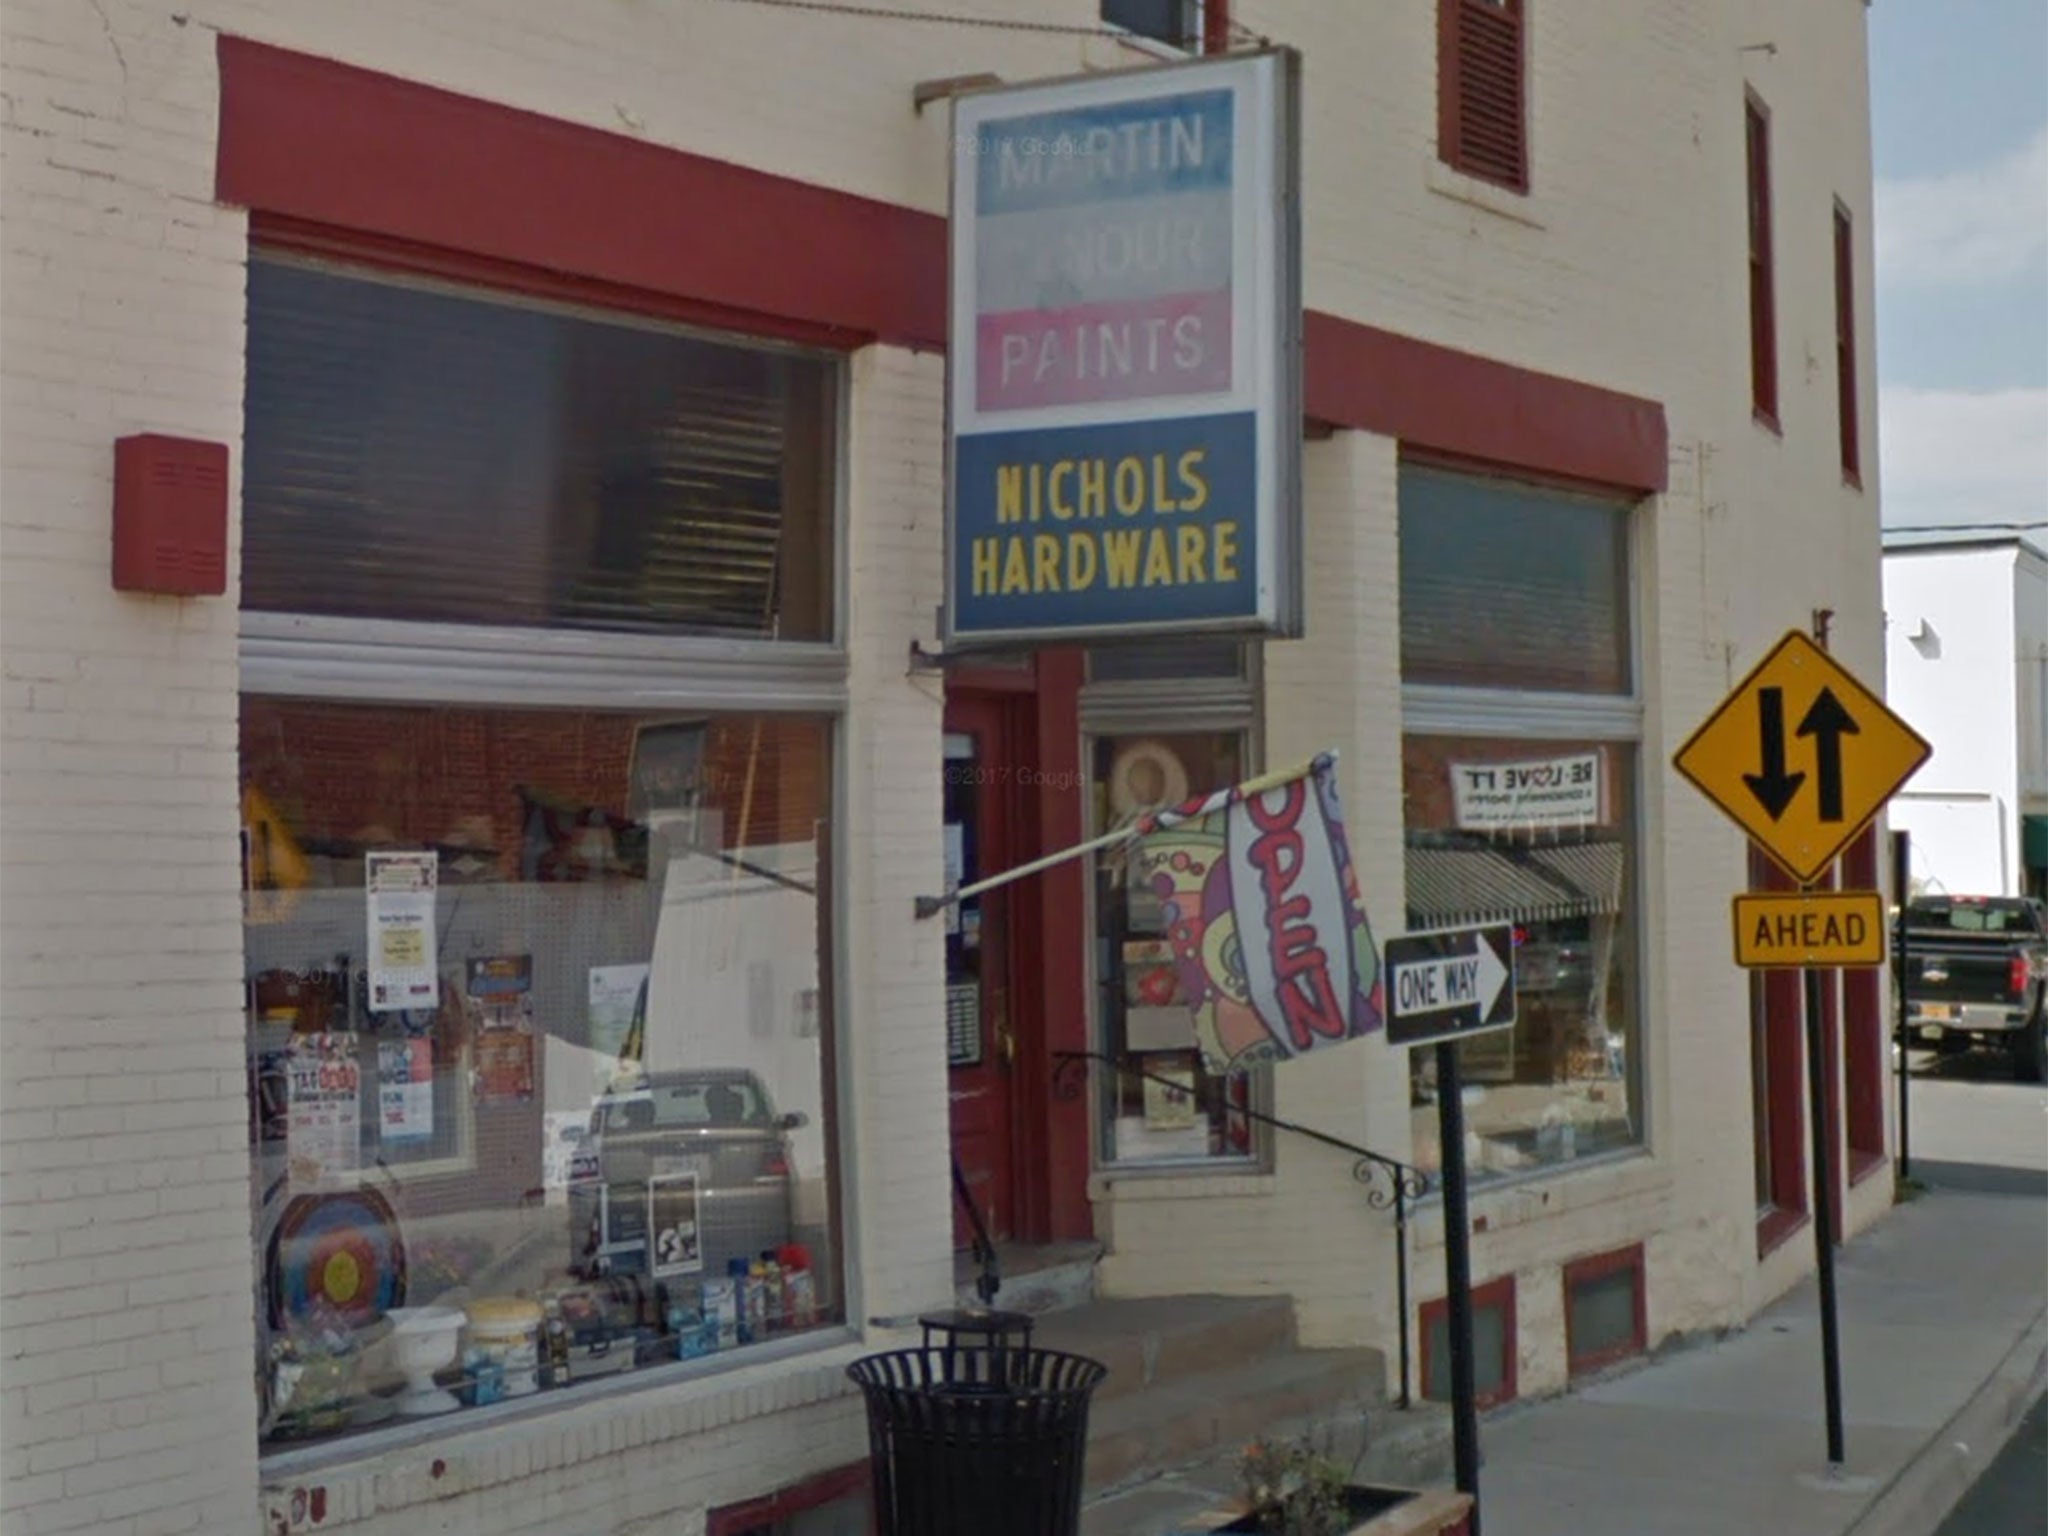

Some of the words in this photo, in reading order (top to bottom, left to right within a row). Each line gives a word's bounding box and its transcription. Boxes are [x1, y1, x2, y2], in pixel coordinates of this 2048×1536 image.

[1001, 113, 1204, 190] MARTIN
[1001, 315, 1204, 387] PAINTS
[997, 450, 1208, 524] NICHOLS
[972, 521, 1238, 597] HARDWARE
[1247, 778, 1346, 1050] OPEN
[1753, 912, 1867, 948] AHEAD
[1400, 966, 1438, 1010] ONE
[1444, 959, 1480, 1001] WAY
